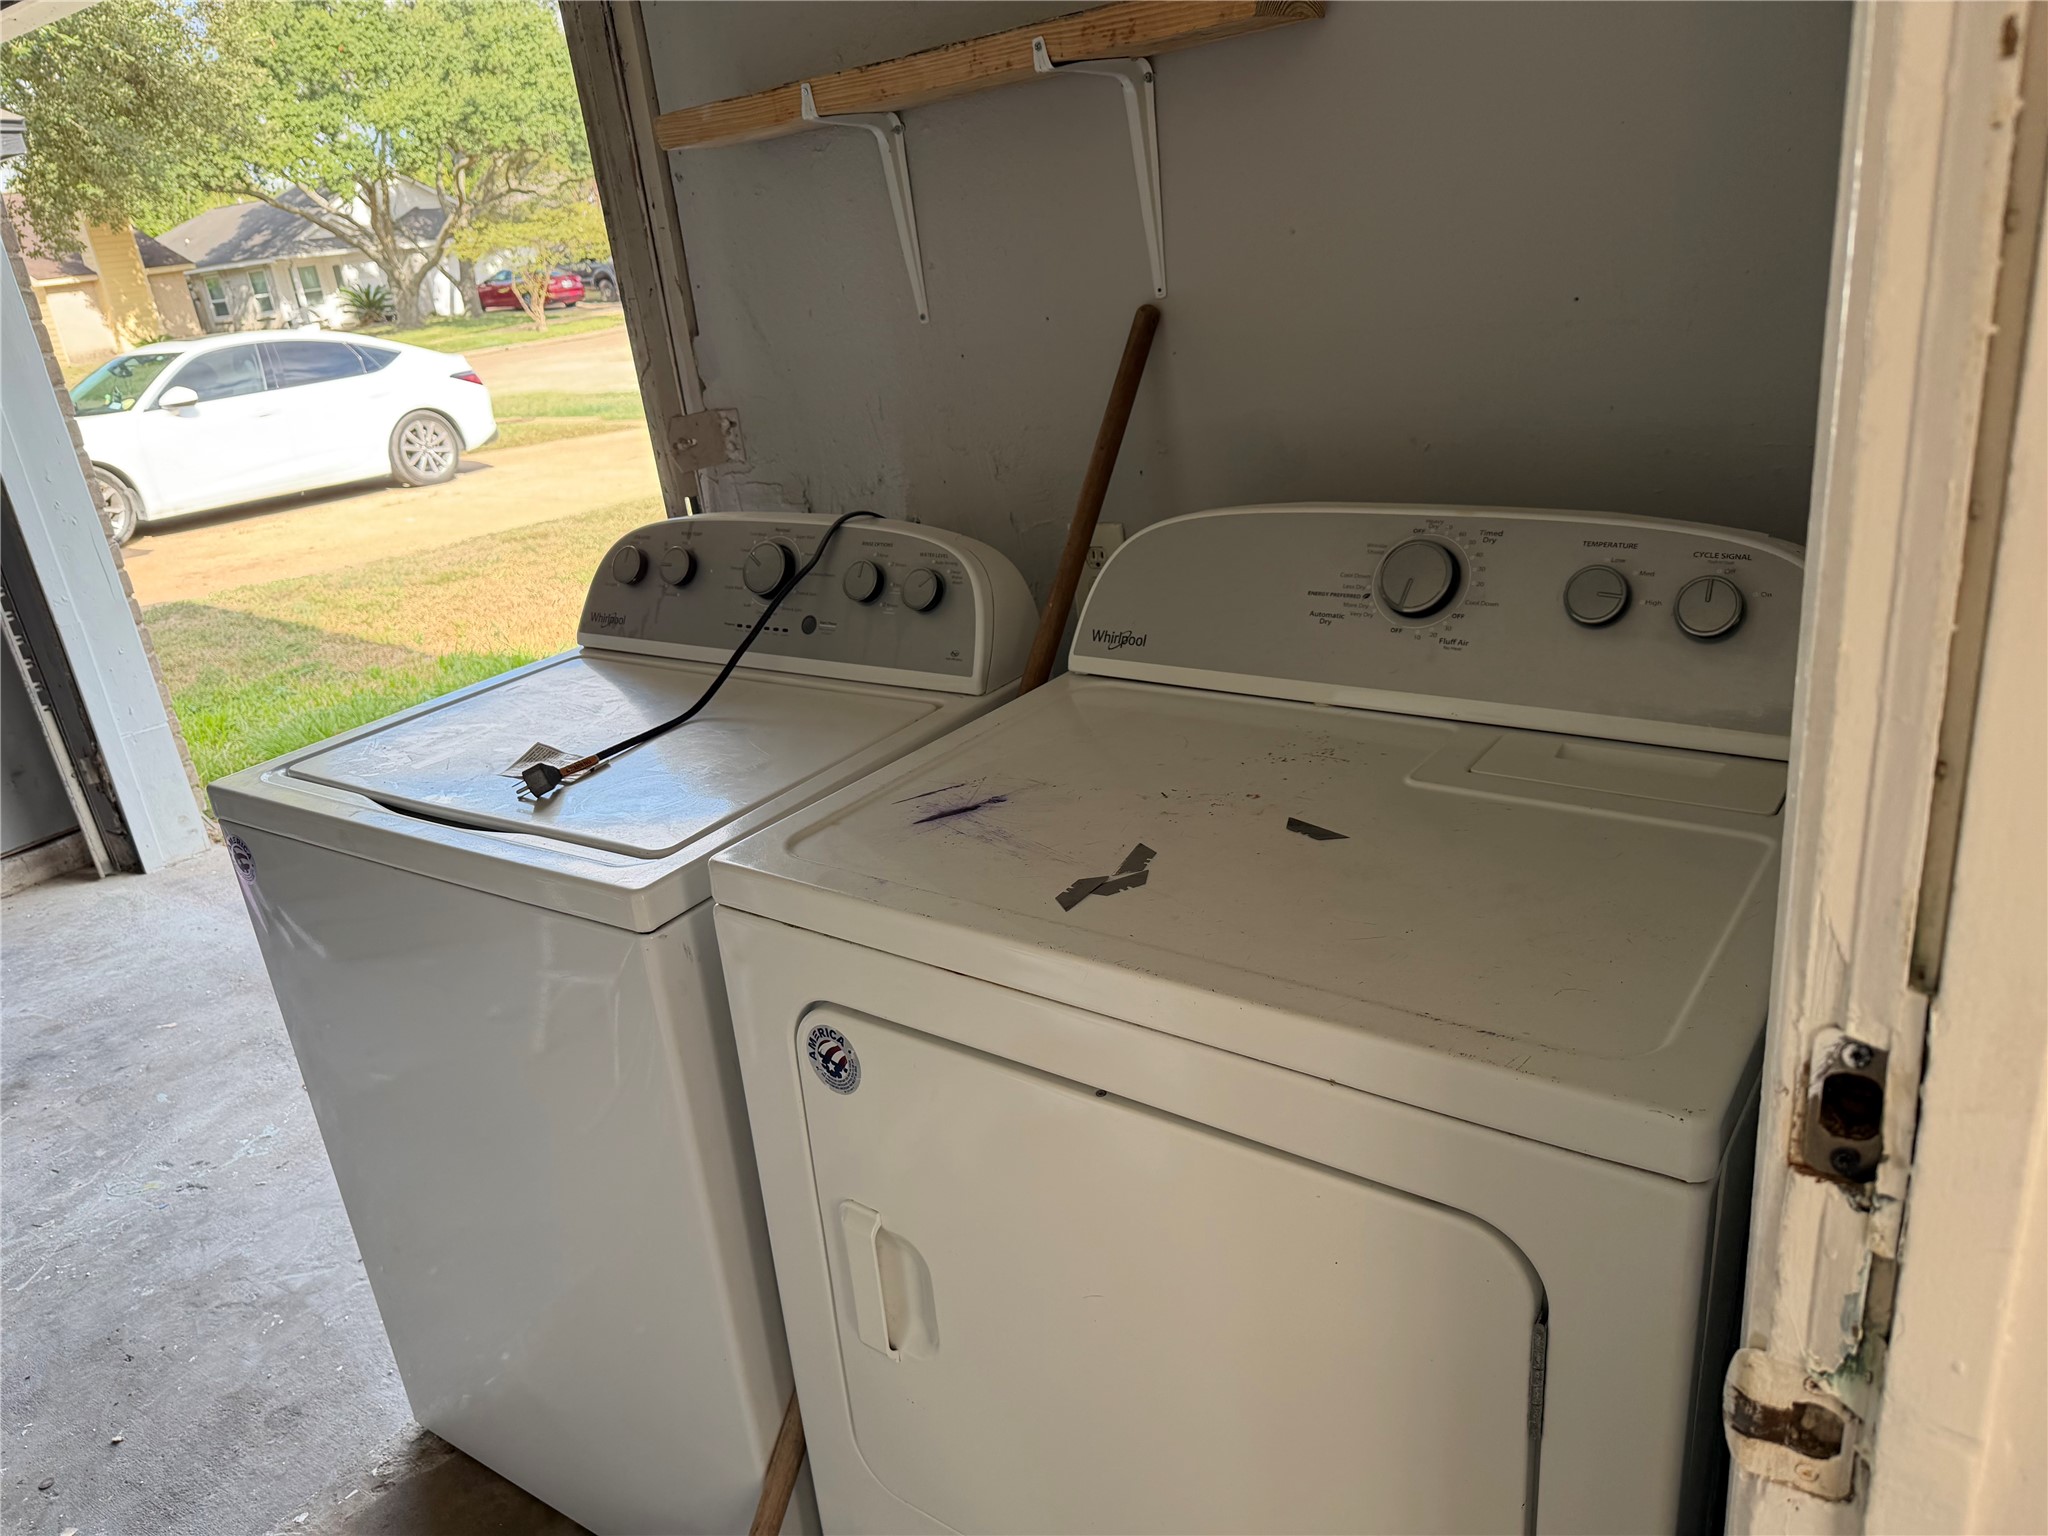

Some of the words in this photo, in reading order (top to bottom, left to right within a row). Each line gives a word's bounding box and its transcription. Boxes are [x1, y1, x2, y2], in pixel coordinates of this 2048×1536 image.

[1583, 540, 1639, 550] TEMPERATURE
[1721, 553, 1752, 561] SIGNAL
[591, 611, 626, 628] Whirlpool
[1309, 610, 1345, 619] Automatic
[1319, 617, 1332, 625] Dry
[1092, 628, 1147, 650] Whirlpool
[808, 1027, 844, 1061] AMERICA
